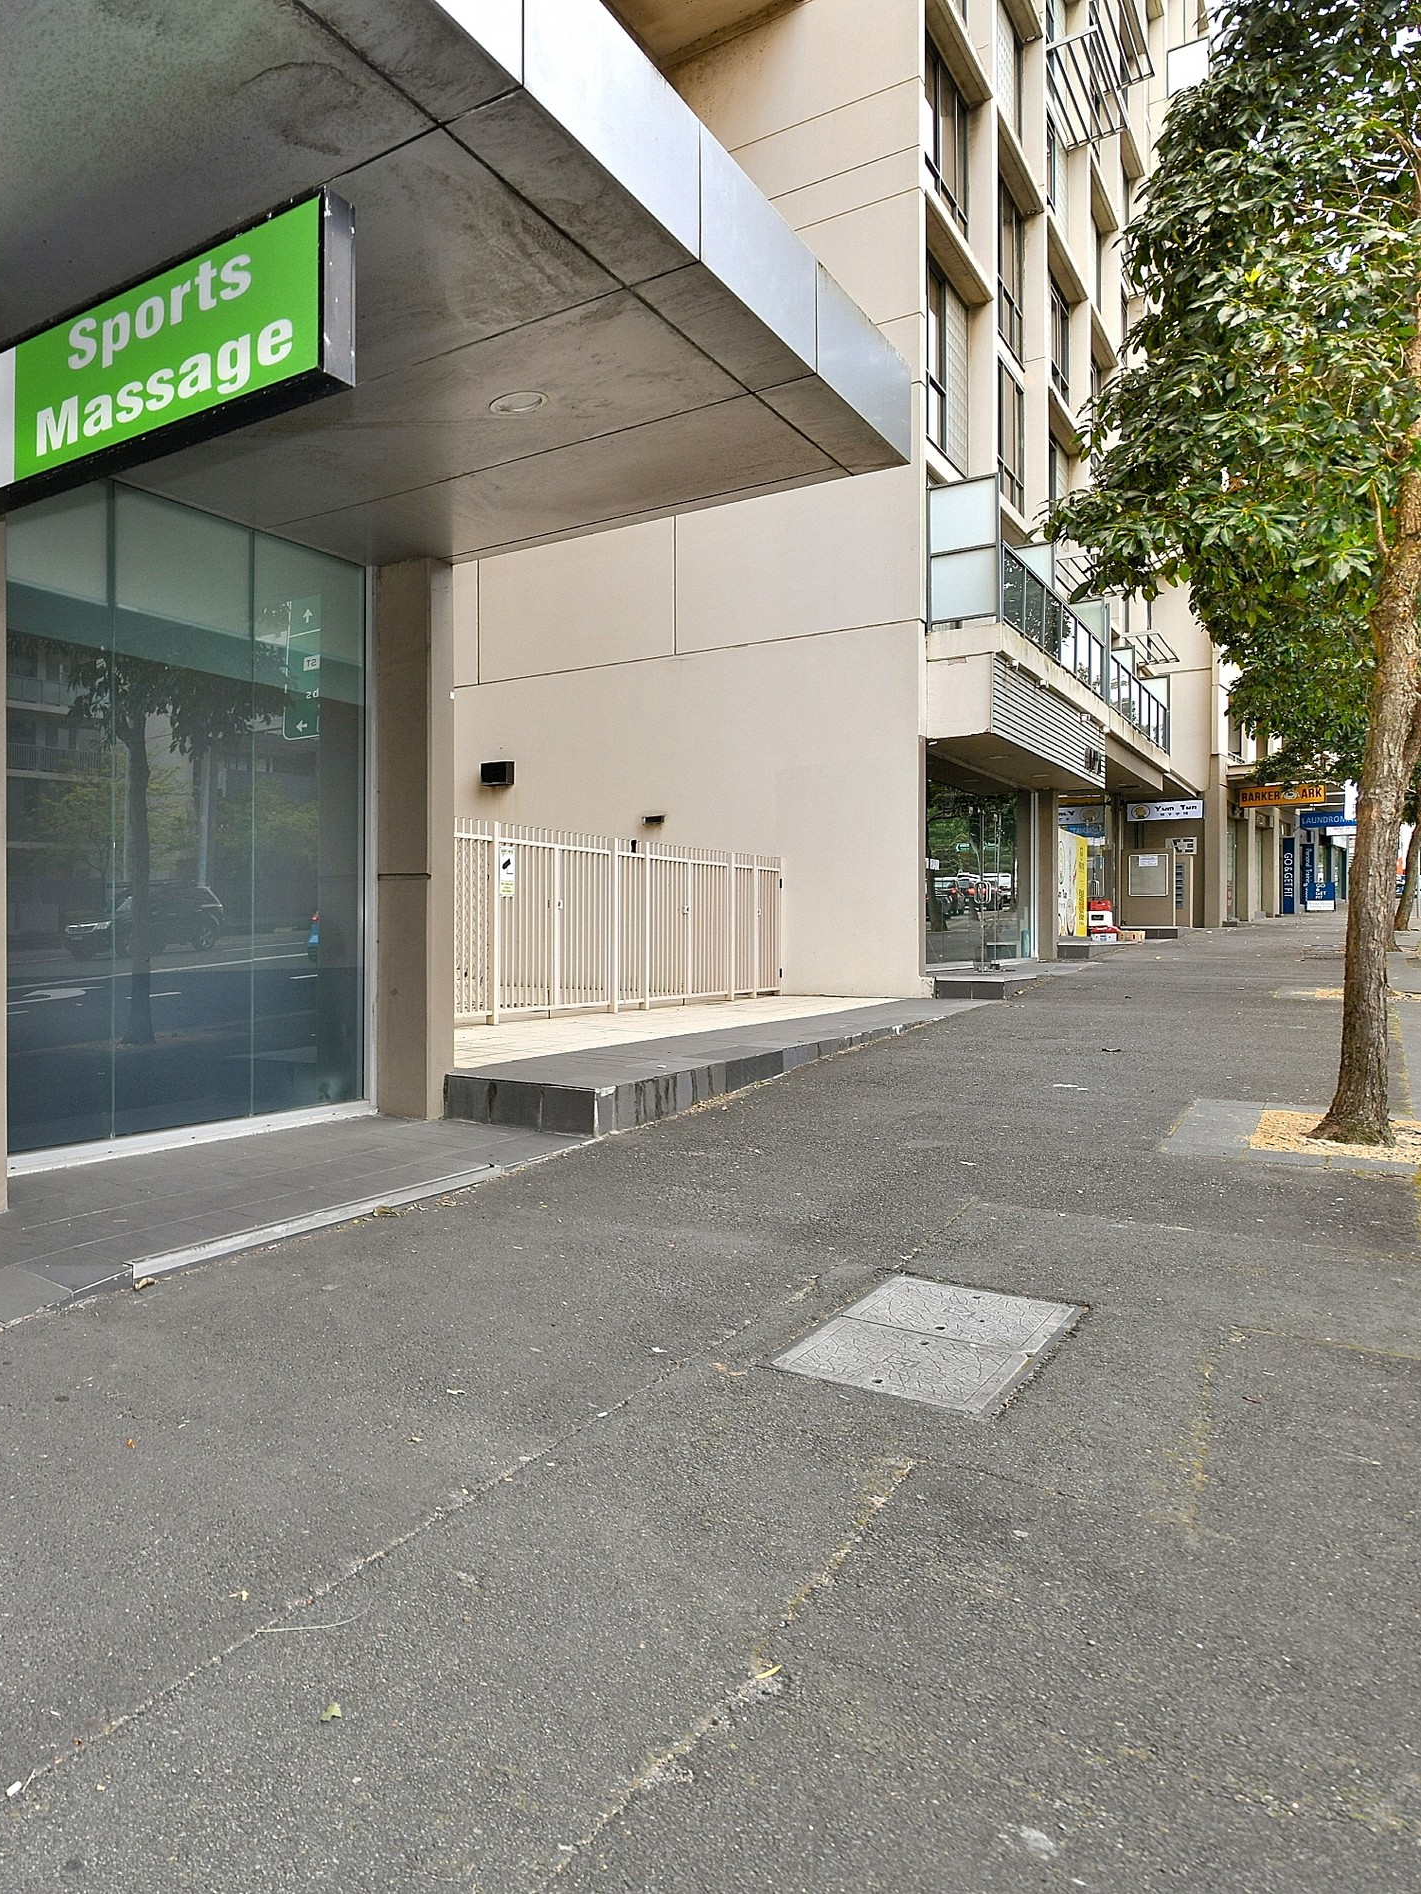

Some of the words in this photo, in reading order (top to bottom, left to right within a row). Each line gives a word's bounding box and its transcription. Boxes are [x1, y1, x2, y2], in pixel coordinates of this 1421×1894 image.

[67, 253, 252, 370] Sports
[36, 317, 293, 457] Massage
[1301, 787, 1322, 799] ARK
[1283, 852, 1293, 866] GO
[1283, 872, 1293, 887] GET
[1283, 887, 1293, 898] FIT
